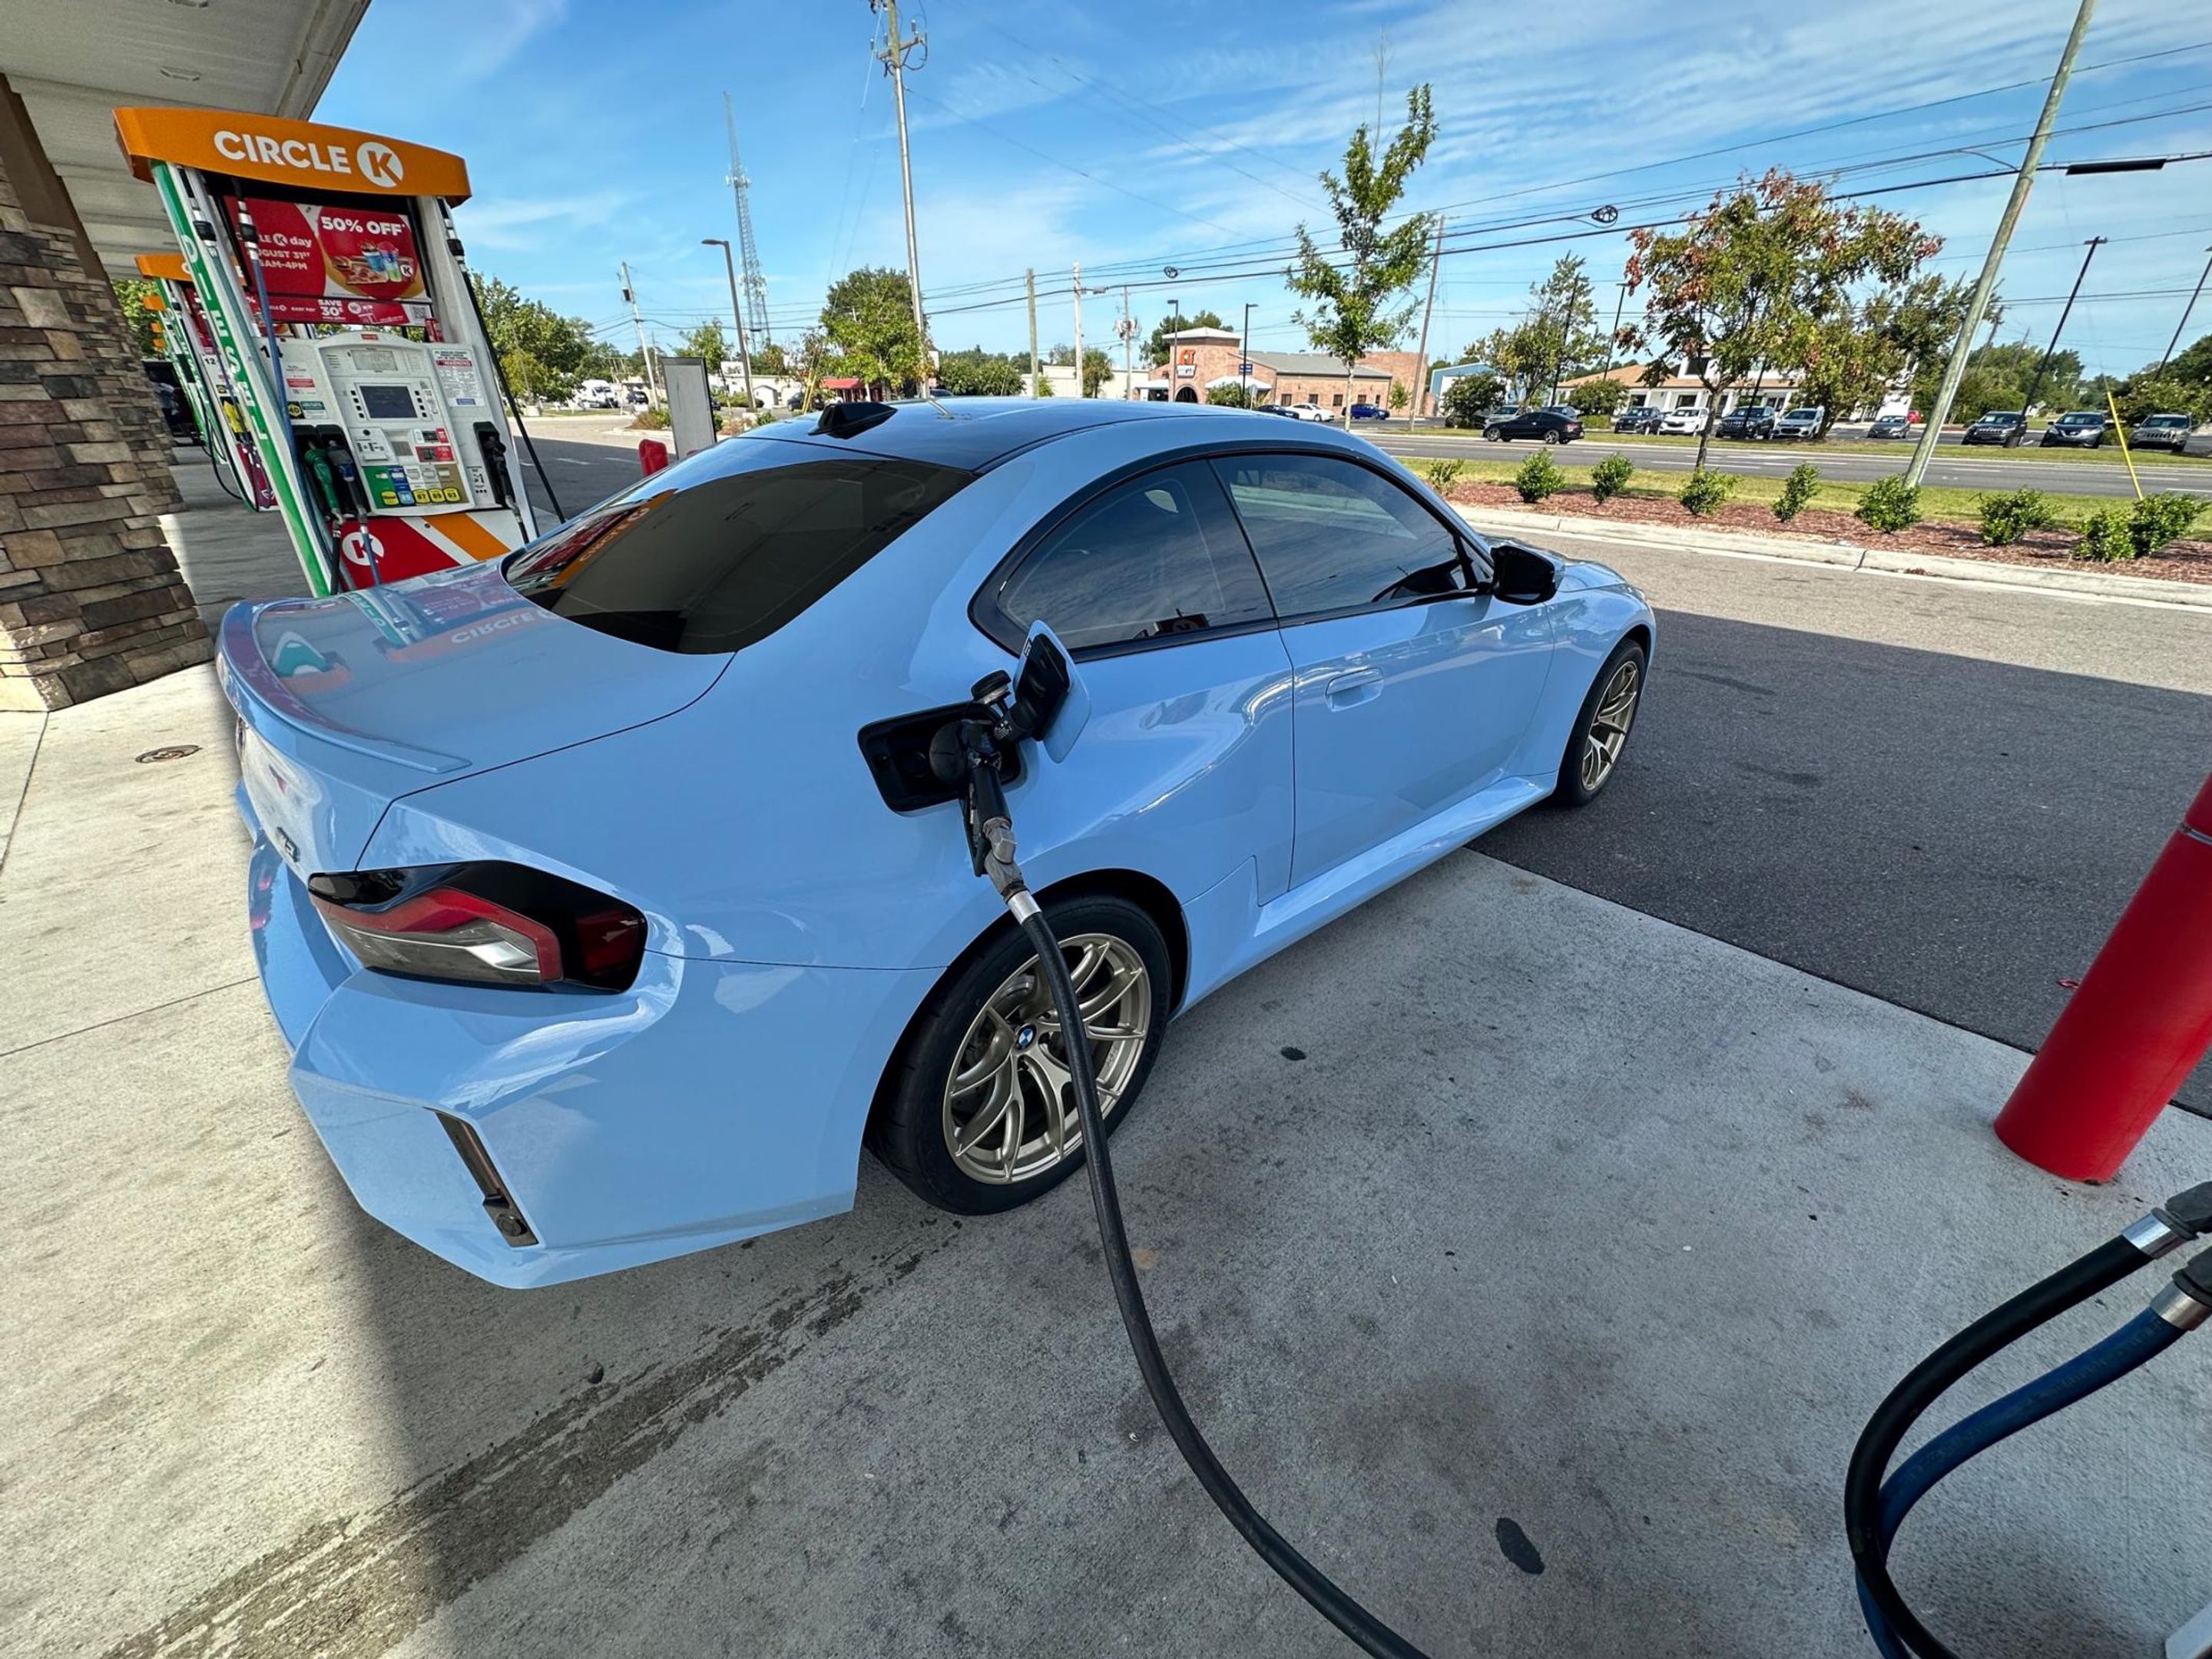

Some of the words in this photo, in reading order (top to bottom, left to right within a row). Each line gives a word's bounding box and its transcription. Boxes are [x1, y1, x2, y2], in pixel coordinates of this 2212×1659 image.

[214, 130, 352, 174] CIRCLE
[366, 147, 403, 184] K
[290, 236, 312, 247] day
[320, 216, 363, 233] 50%
[180, 233, 269, 440] DIESEL
